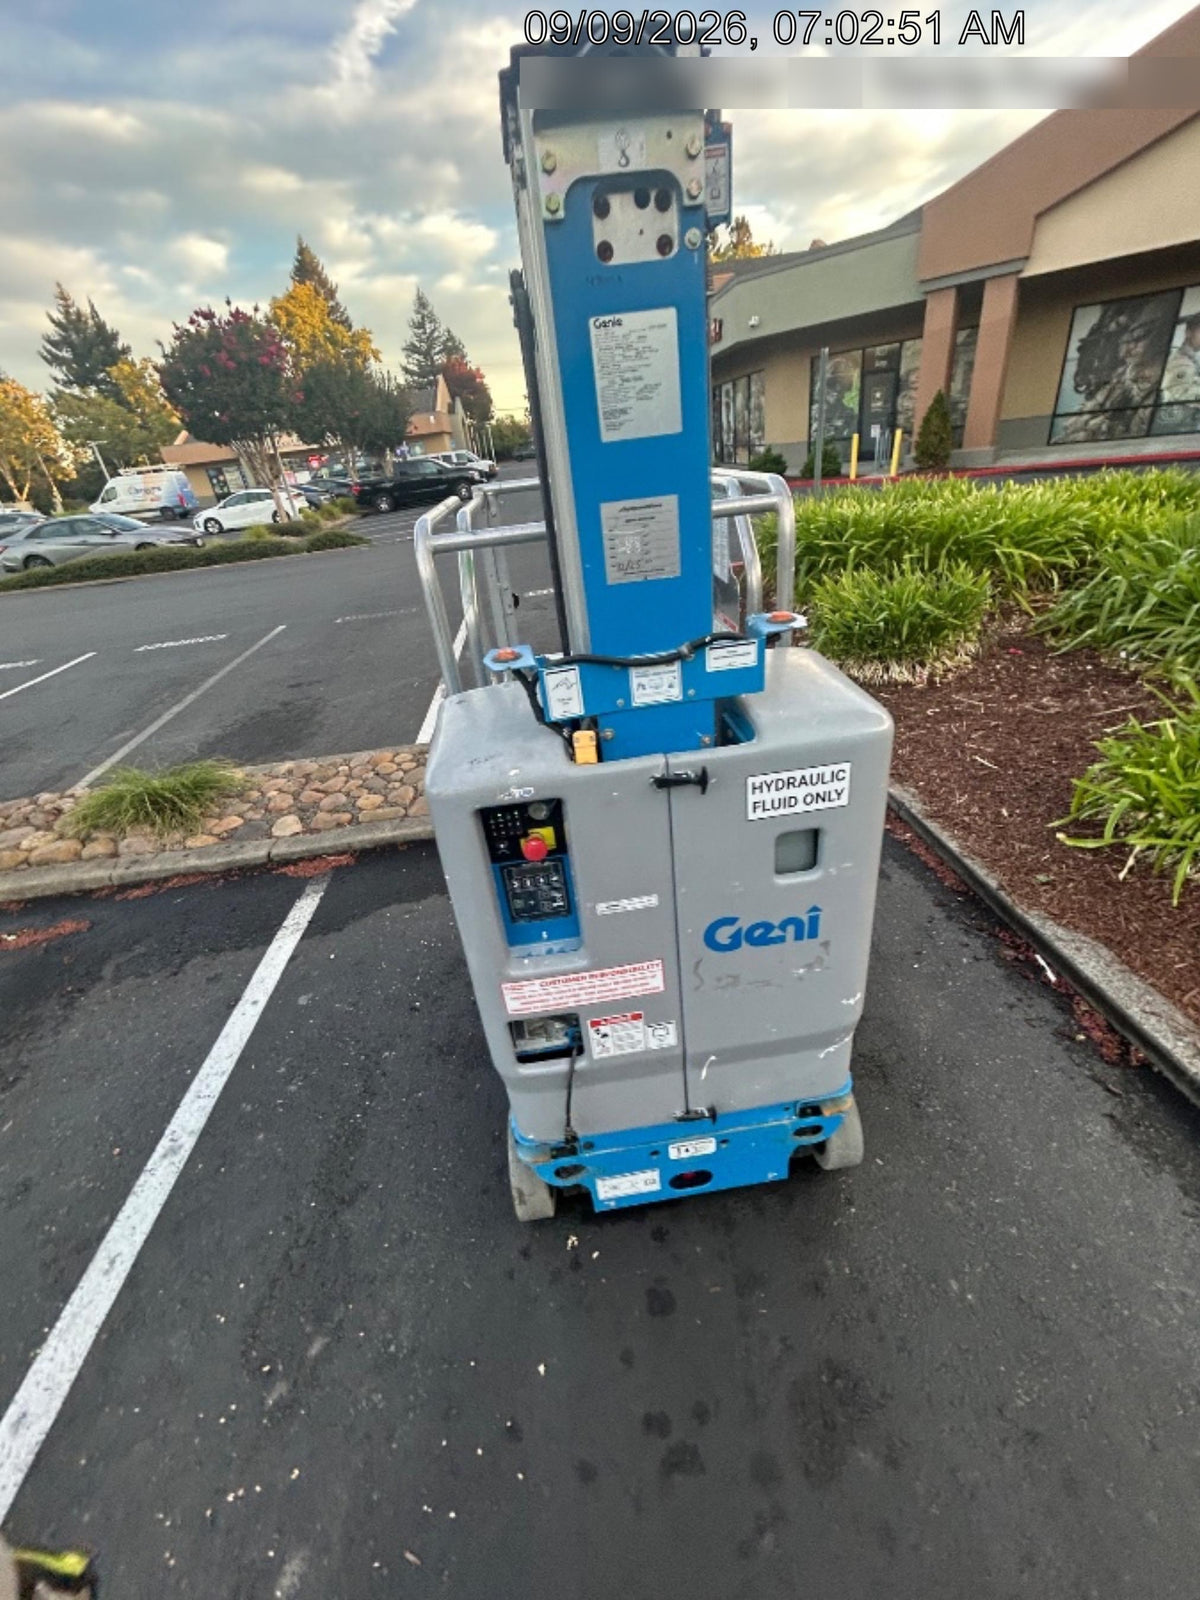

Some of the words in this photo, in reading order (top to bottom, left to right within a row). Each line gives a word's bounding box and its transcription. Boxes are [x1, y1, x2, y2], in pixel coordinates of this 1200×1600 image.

[751, 769, 846, 795] HYDRAULIC
[752, 795, 798, 814] FLUID
[803, 787, 845, 807] ONLY
